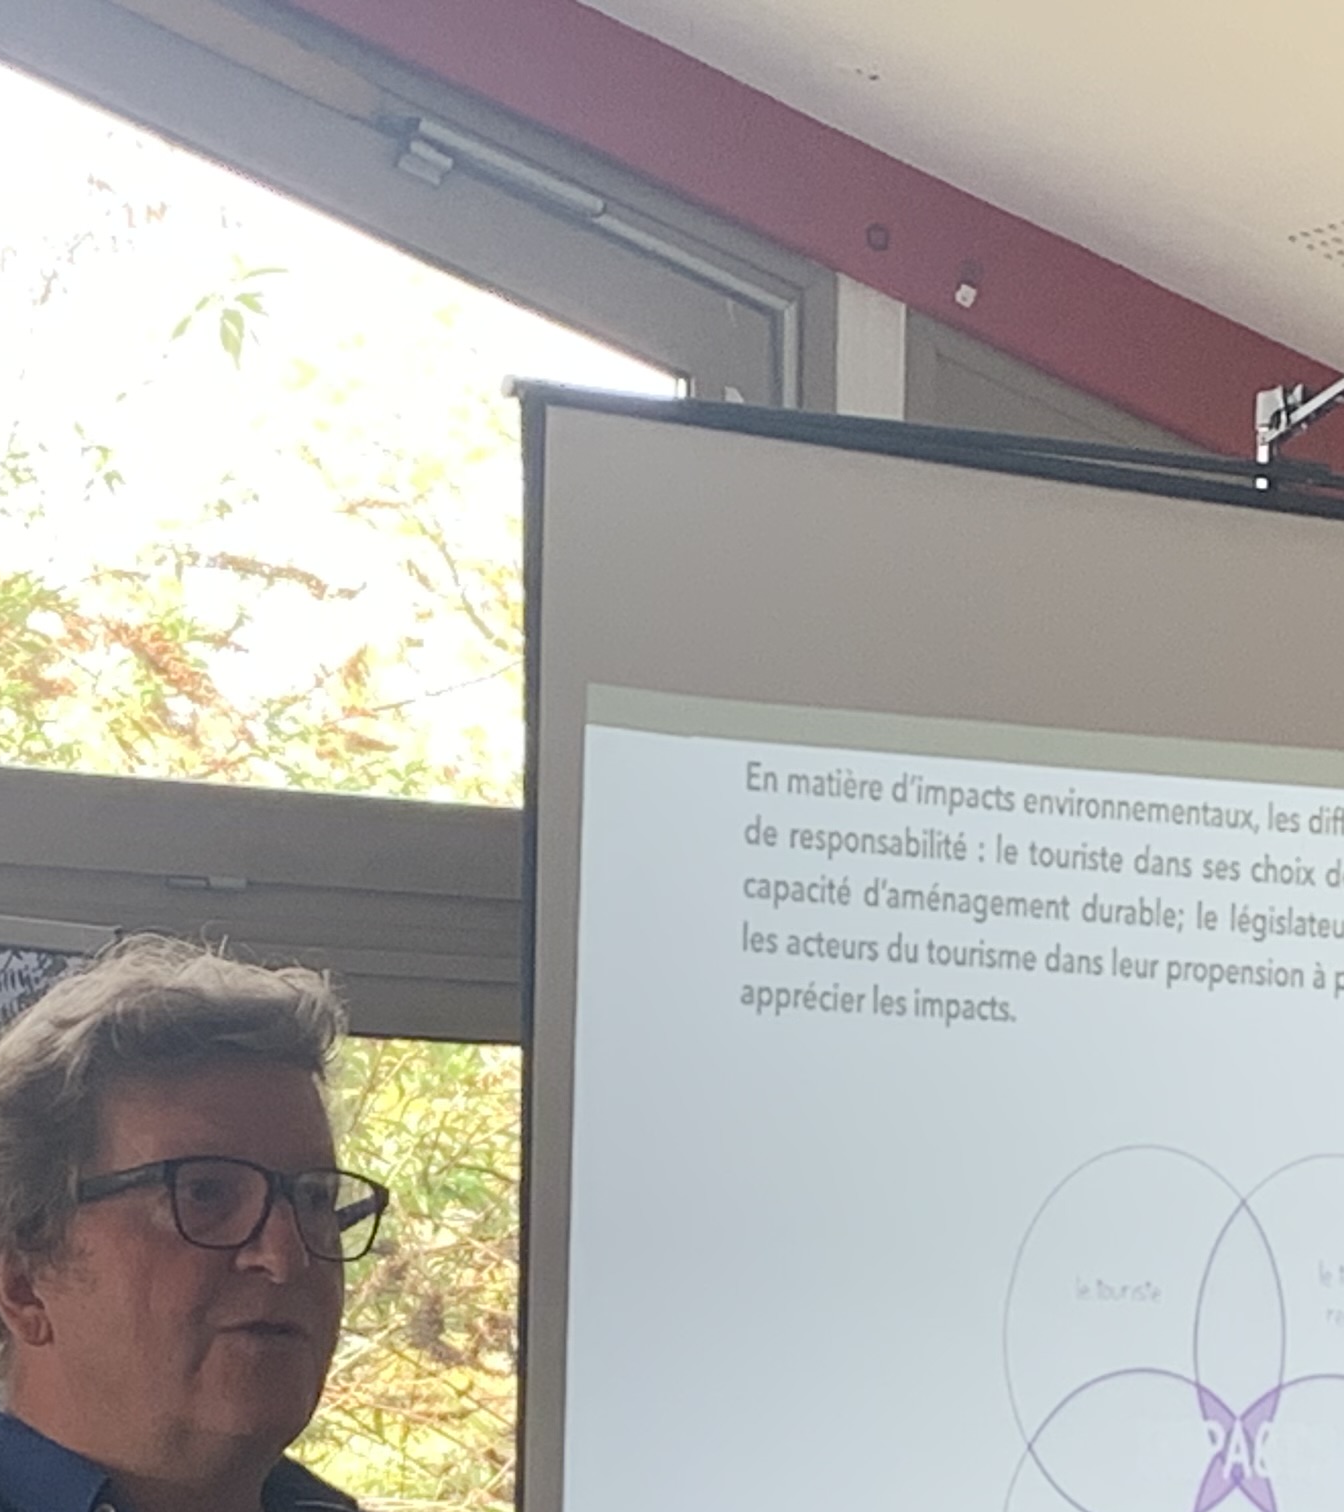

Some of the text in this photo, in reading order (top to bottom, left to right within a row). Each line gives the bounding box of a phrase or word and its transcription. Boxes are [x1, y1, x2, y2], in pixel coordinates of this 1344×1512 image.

[746, 761, 778, 793] En
[787, 769, 883, 801] matière
[1023, 787, 1260, 834] environnementaux,
[1268, 801, 1301, 833] les
[745, 813, 778, 847] de
[789, 826, 967, 861] responsabilité
[996, 833, 1018, 865] le
[1029, 841, 1123, 874] touriste
[1134, 844, 1192, 878] dans
[1202, 857, 1241, 882] ses
[1251, 853, 1315, 887] choix
[743, 874, 851, 910] capacité
[1081, 893, 1184, 933] durable;
[1196, 900, 1218, 931] le
[742, 920, 778, 954] les
[786, 932, 879, 962] acteurs
[887, 931, 918, 964] du
[927, 939, 1037, 972] tourisme
[1045, 943, 1103, 976] dans
[1112, 947, 1159, 980] leur
[1166, 958, 1304, 992] propension
[1312, 961, 1326, 990] à
[740, 981, 1016, 1028] apprécier les impacts.
